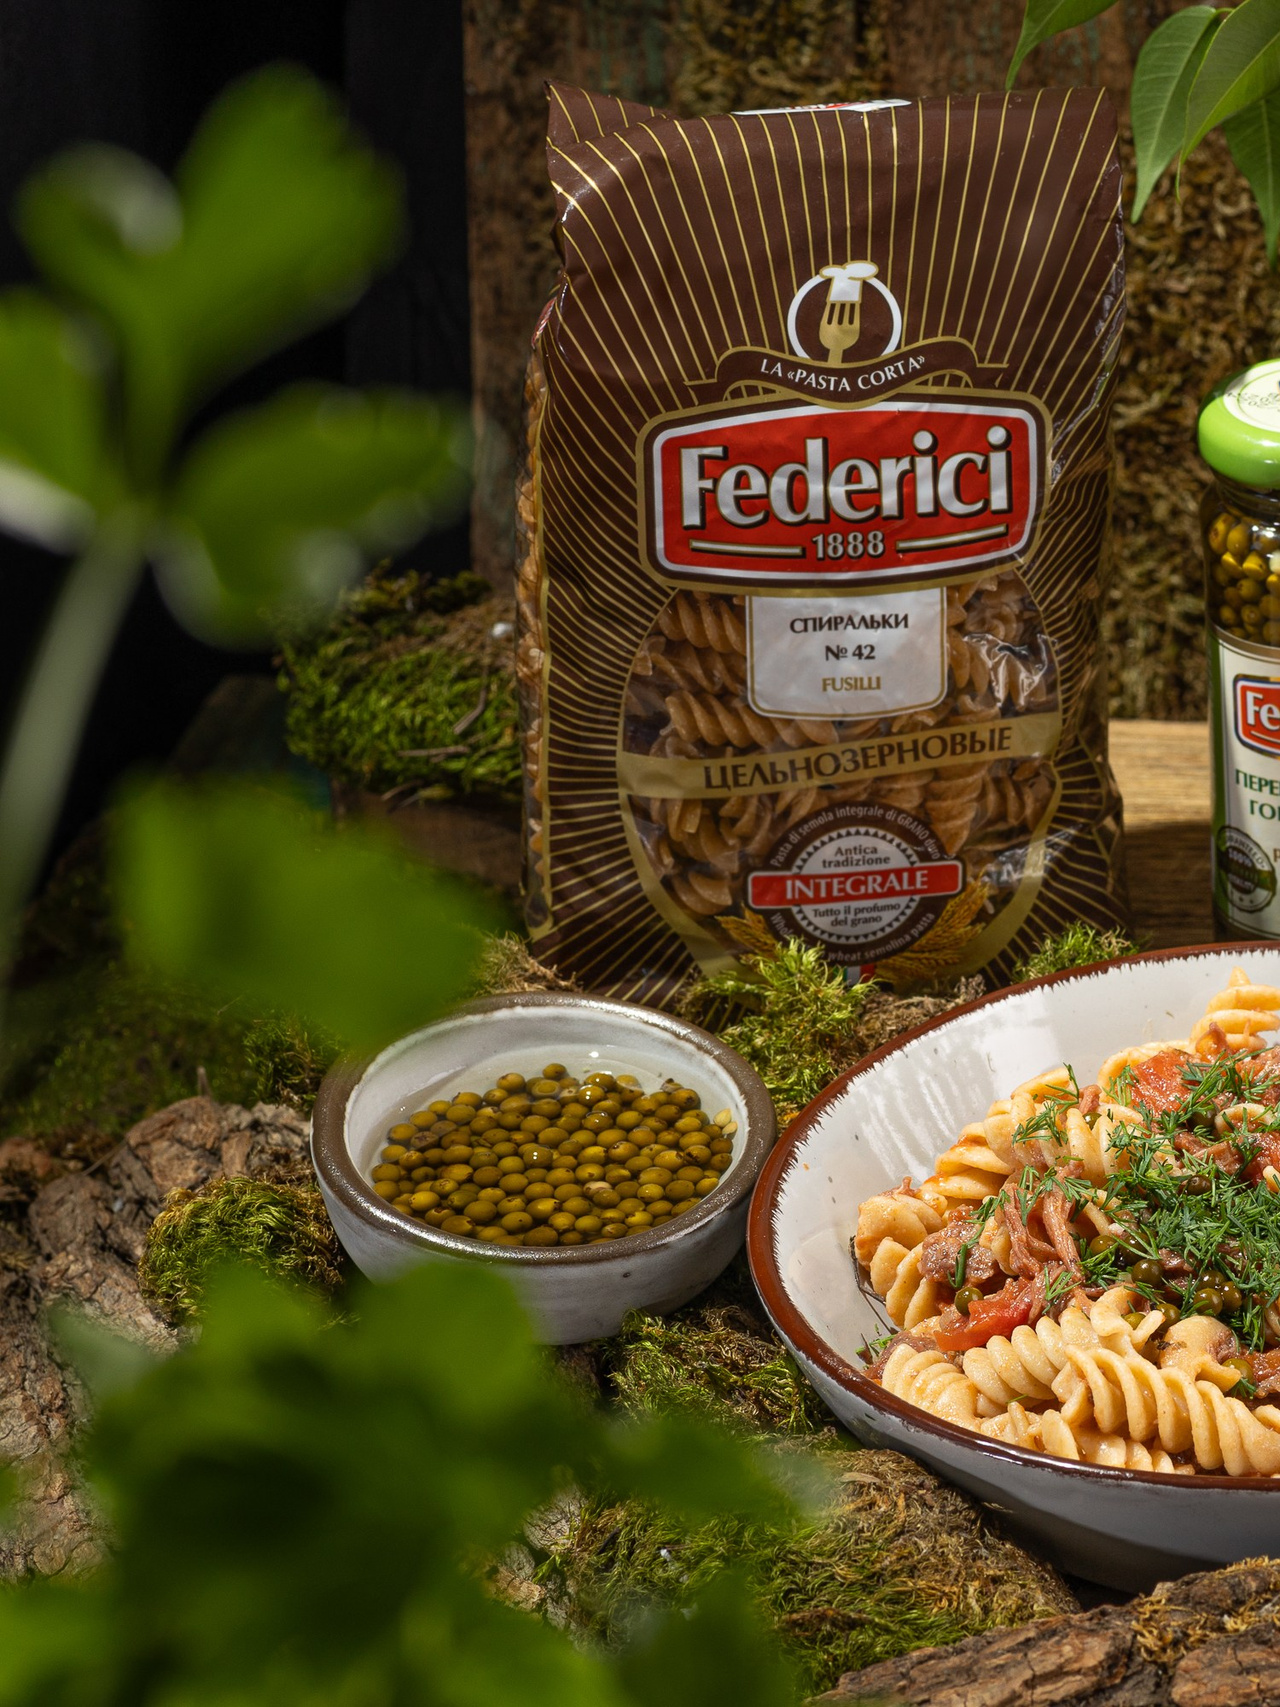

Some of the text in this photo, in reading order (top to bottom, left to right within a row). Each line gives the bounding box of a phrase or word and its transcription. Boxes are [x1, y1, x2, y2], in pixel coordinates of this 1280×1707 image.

[760, 355, 925, 392] LA «PASTA CORTA»
[679, 424, 1013, 529] Federici
[811, 530, 885, 560] 1888
[789, 613, 909, 634] СПИРАЛЬКИ
[825, 643, 876, 662] № 42
[821, 675, 882, 693] FUSILLI
[704, 726, 1013, 792] ЦЕЛЬНОЗЕРНОВЫЕ
[770, 805, 941, 868] Pasta di semola integrale di GRANO duro
[822, 854, 891, 869] tradizione
[834, 845, 878, 858] Antica
[785, 870, 928, 900] INTEGRALE
[812, 902, 901, 919] Tutto il profumo
[831, 915, 882, 928] del grano
[864, 933, 911, 958] semolina
[912, 912, 936, 935] pasta
